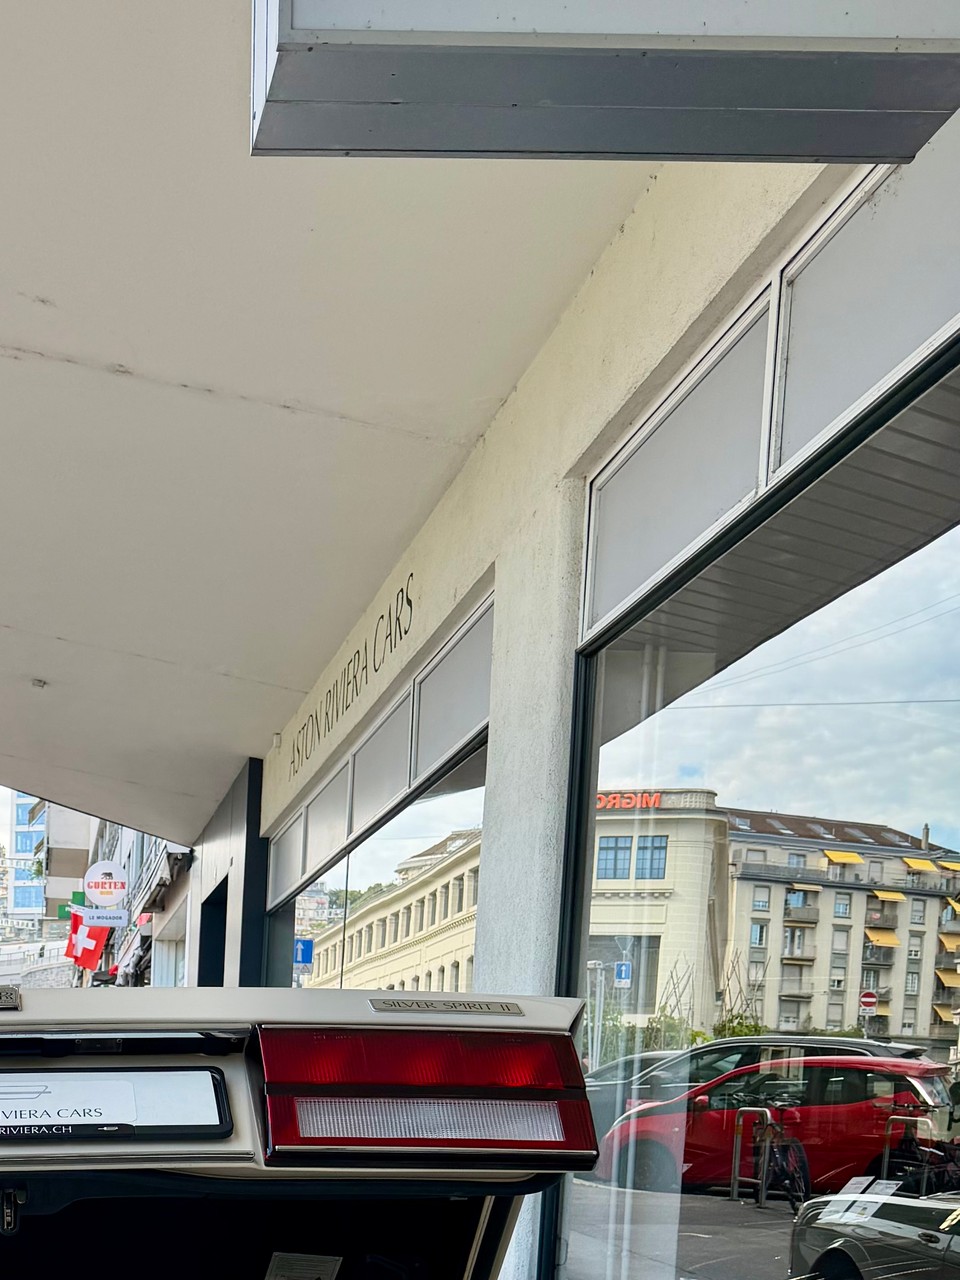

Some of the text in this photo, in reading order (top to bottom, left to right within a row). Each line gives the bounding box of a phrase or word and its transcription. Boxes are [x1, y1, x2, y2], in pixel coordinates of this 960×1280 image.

[289, 572, 414, 782] ASTON RIVIERA CARS
[382, 1000, 511, 1012] SILVER SPIRIT II
[57, 1107, 103, 1118] CARS
